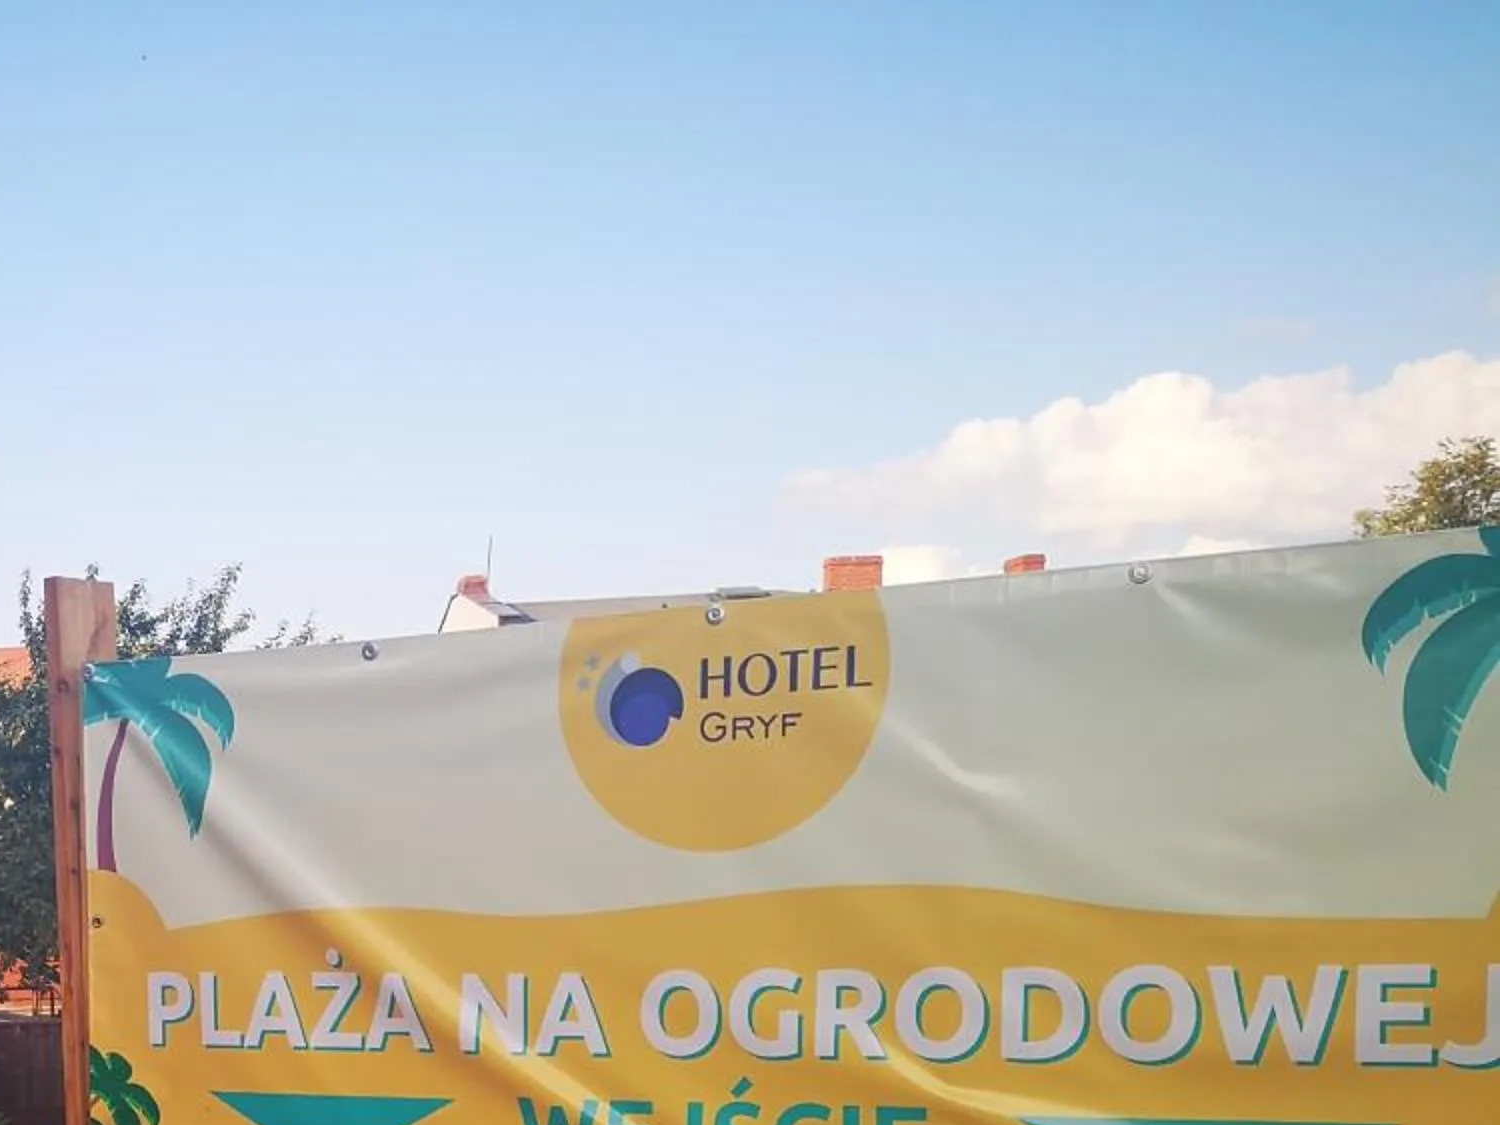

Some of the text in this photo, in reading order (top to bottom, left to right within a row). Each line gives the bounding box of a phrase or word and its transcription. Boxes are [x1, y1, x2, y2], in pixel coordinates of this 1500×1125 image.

[699, 645, 873, 701] HOTEL
[699, 711, 802, 744] GRYF
[146, 947, 1500, 1069] PLAŻA NA OGRODOWEJ
